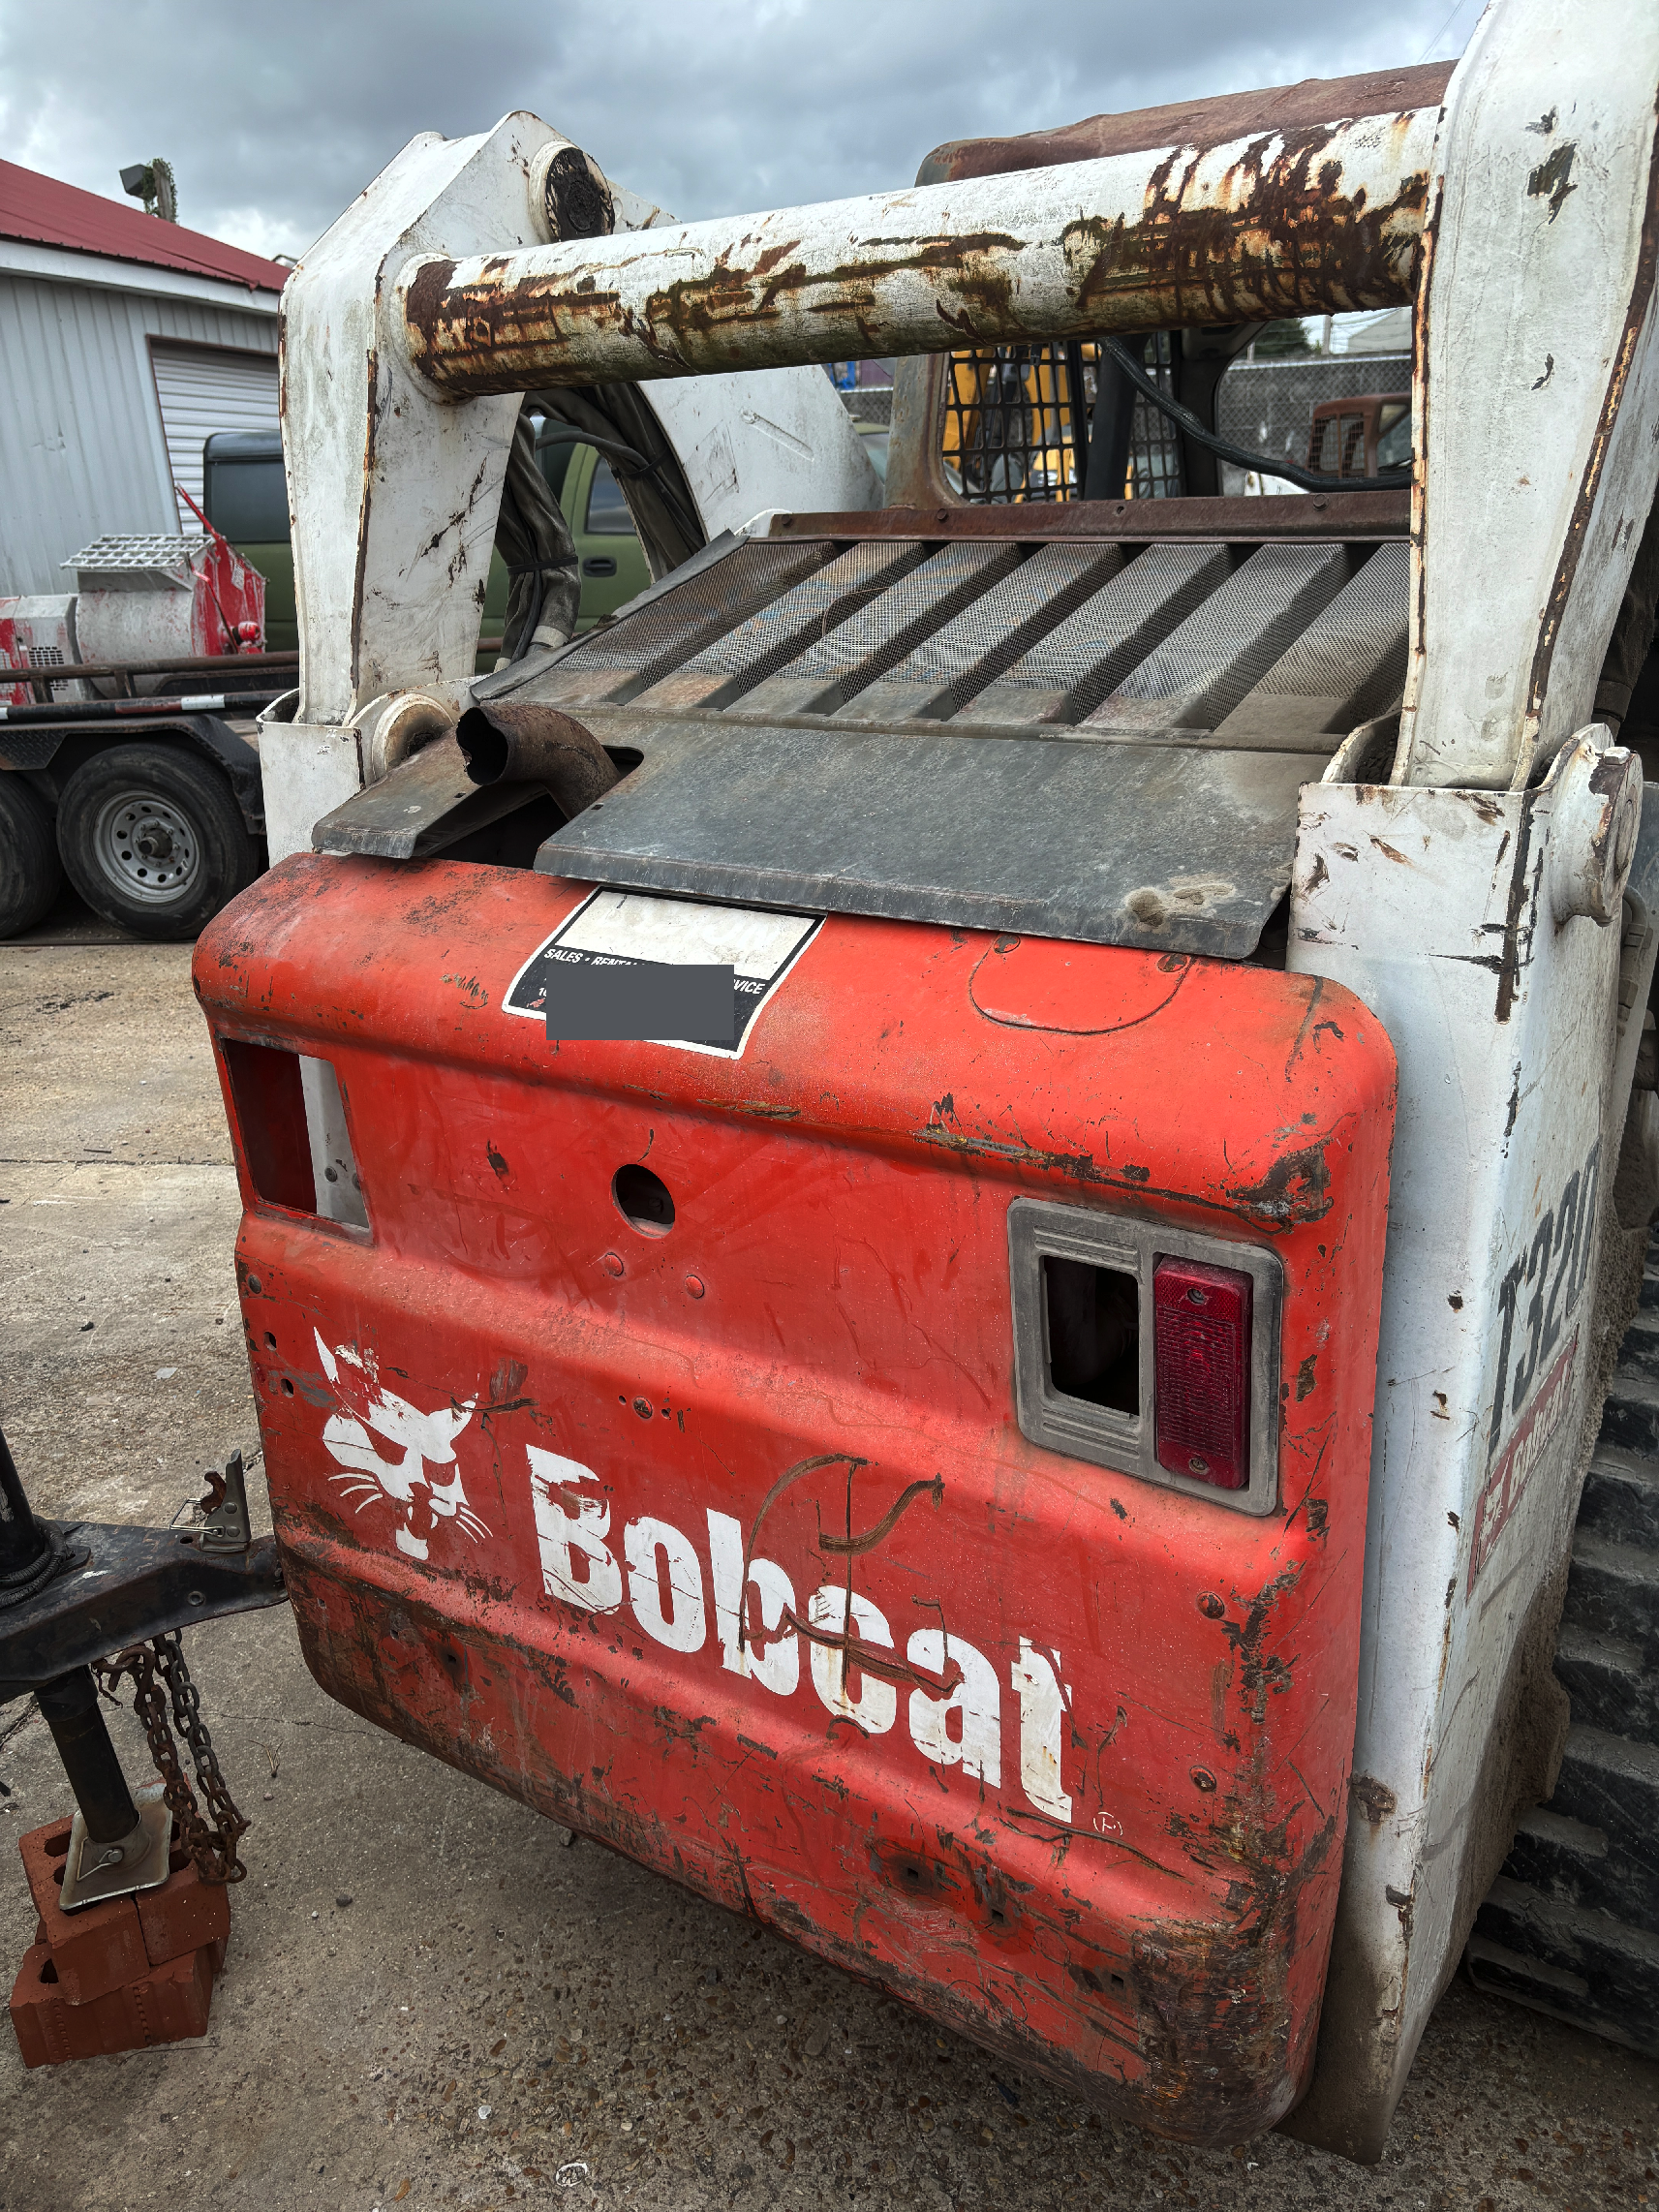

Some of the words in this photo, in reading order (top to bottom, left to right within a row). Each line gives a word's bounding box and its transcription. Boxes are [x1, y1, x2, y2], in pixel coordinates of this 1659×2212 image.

[544, 949, 583, 964] SALES
[734, 979, 765, 995] VICE
[1489, 1135, 1601, 1460] T320
[526, 1444, 1073, 1823] Bobcat
